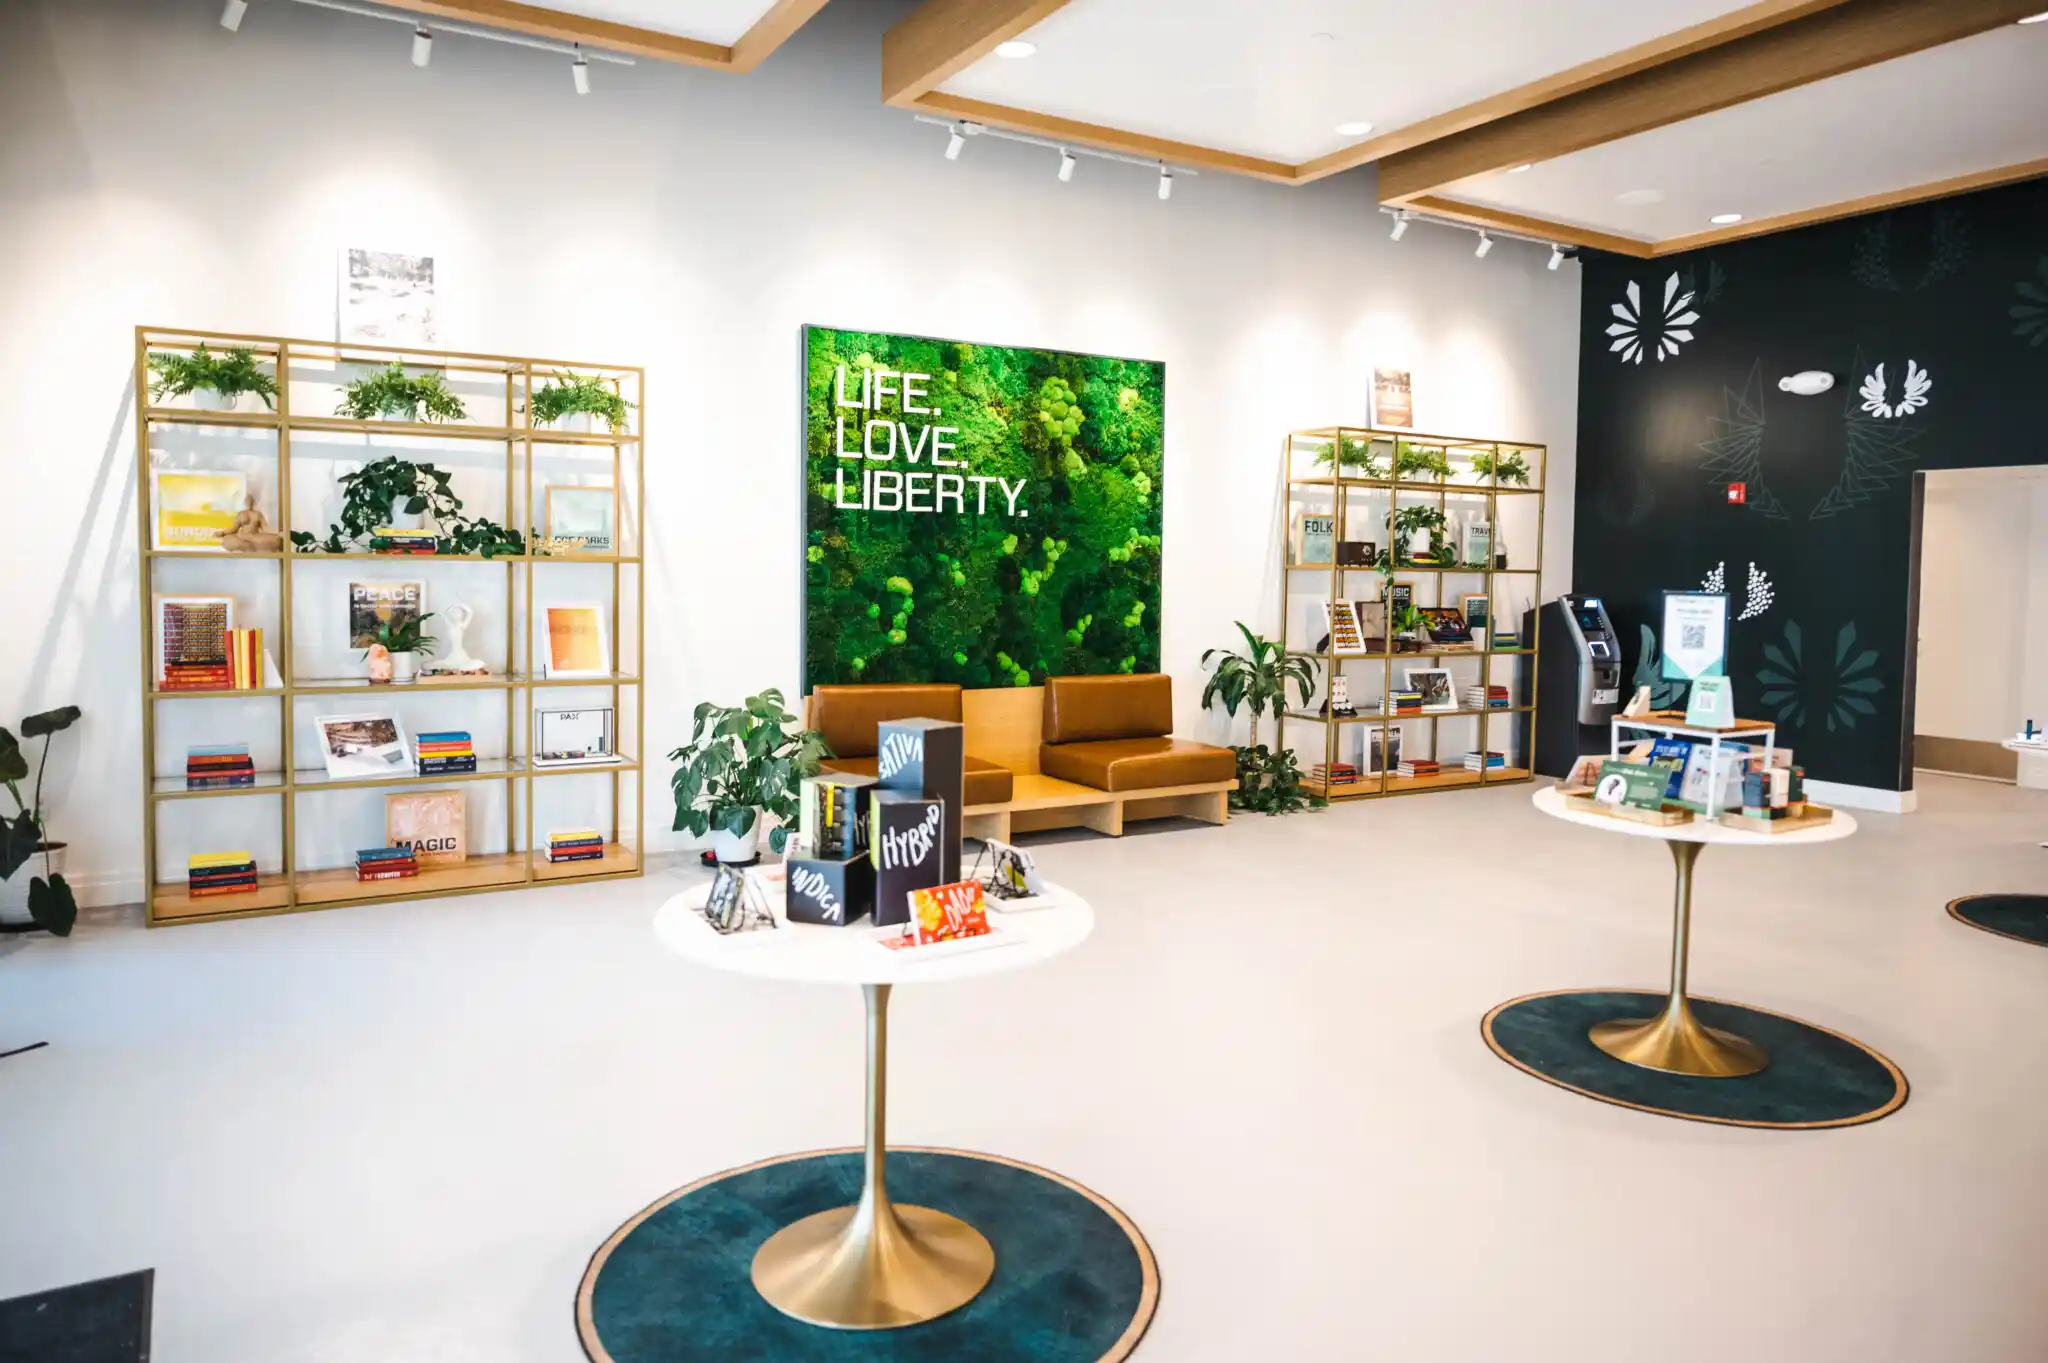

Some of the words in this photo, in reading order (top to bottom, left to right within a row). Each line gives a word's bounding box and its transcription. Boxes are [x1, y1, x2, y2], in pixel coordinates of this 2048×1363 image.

[836, 364, 941, 416] LIFE.
[836, 416, 969, 469] LOVE.
[836, 467, 1029, 518] LIBERTY.
[1304, 520, 1333, 533] FOLK
[353, 587, 416, 601] PEACE
[878, 732, 923, 780] SATIVA
[395, 837, 457, 852] MAGIC
[881, 804, 941, 870] HYBRID
[791, 866, 841, 922] INDICA
